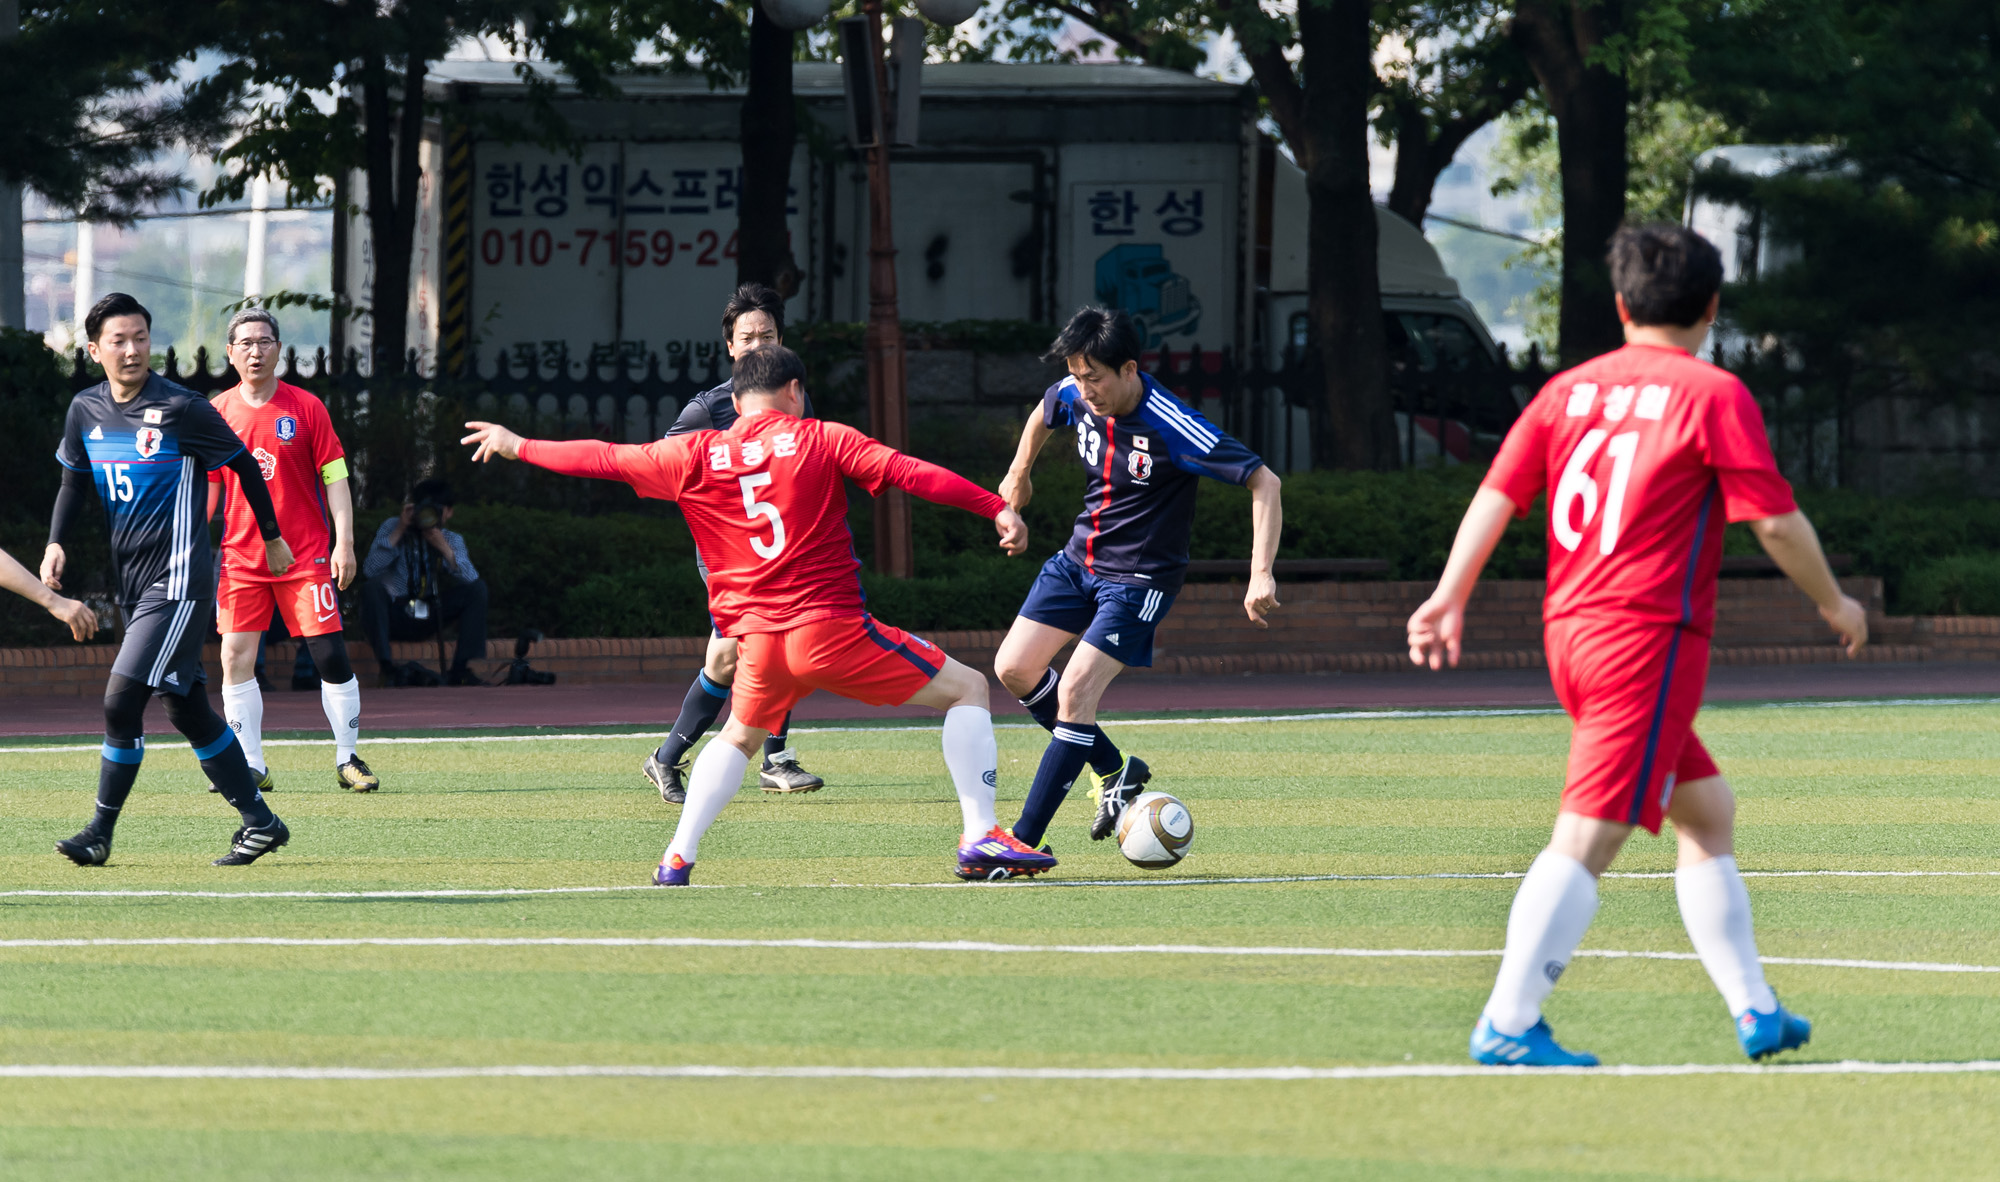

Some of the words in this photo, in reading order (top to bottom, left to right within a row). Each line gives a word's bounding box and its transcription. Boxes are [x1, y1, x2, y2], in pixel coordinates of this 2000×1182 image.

[480, 228, 792, 267] 010-7159-24
[1077, 421, 1101, 467] 33
[102, 462, 135, 502] 15
[1552, 428, 1640, 555] 61
[738, 471, 786, 560] 5
[309, 582, 335, 613] 10
